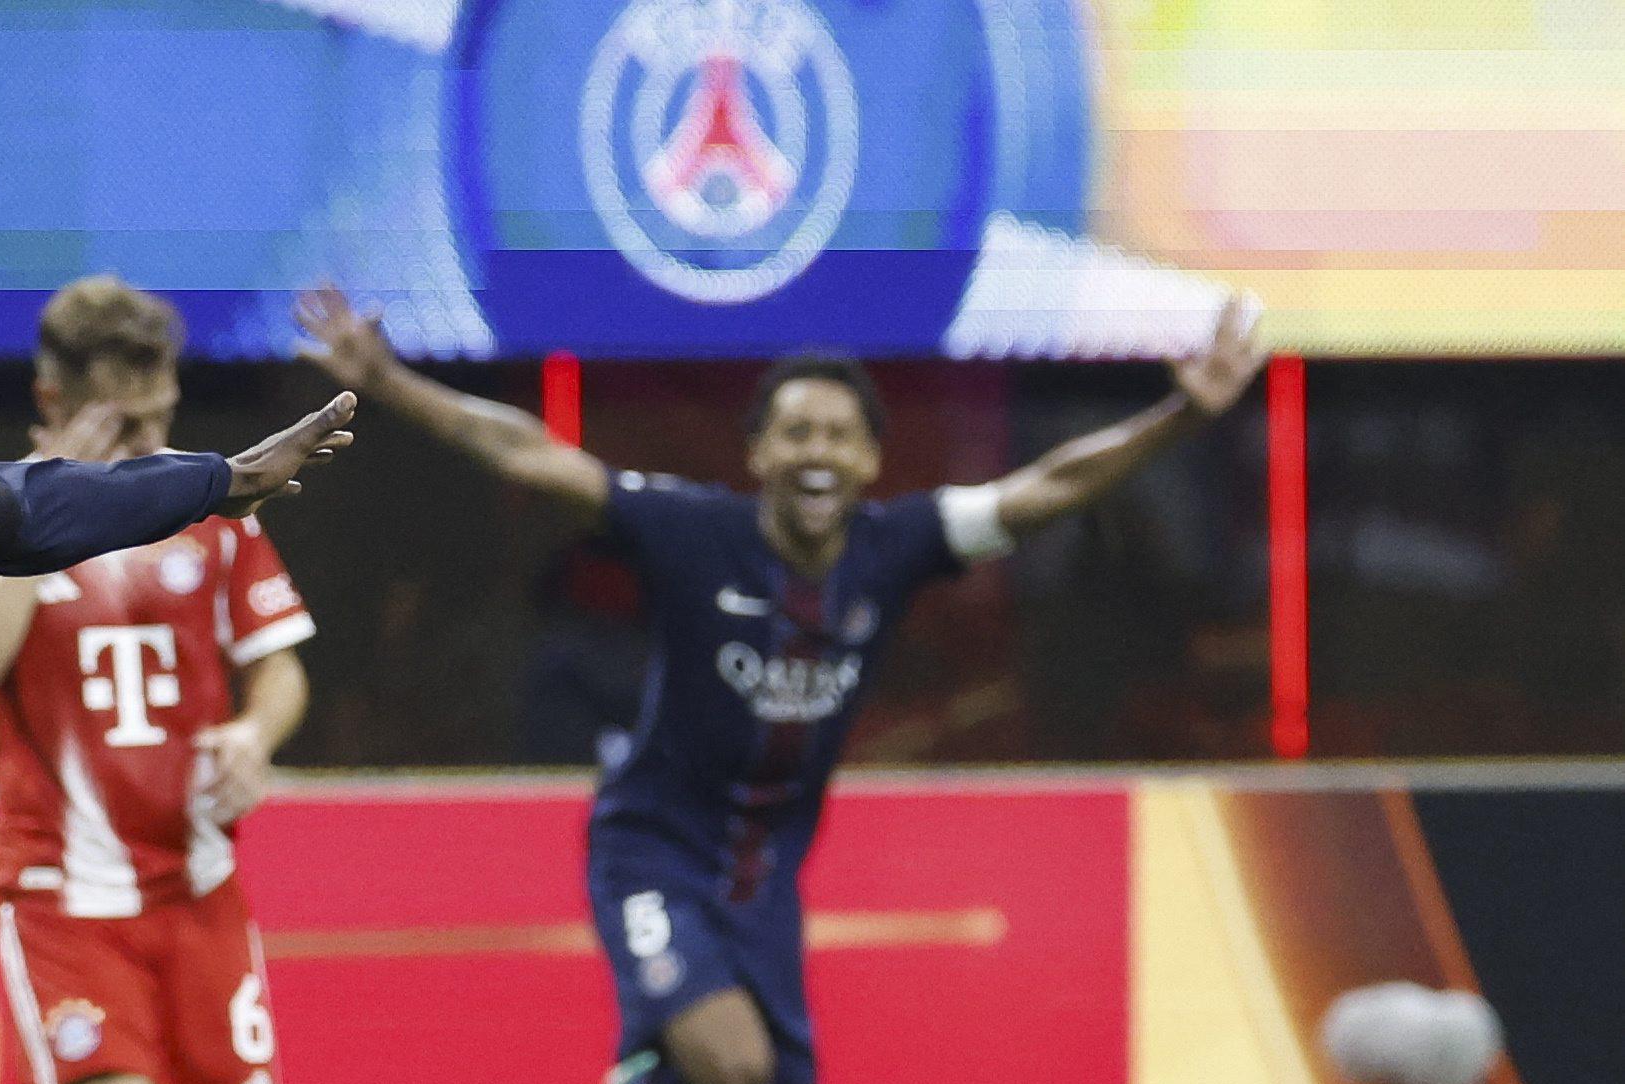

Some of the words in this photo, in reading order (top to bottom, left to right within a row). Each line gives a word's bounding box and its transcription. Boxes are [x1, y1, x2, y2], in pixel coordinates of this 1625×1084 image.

[79, 625, 176, 747] T
[623, 890, 672, 958] 5
[229, 972, 274, 1065] 6
